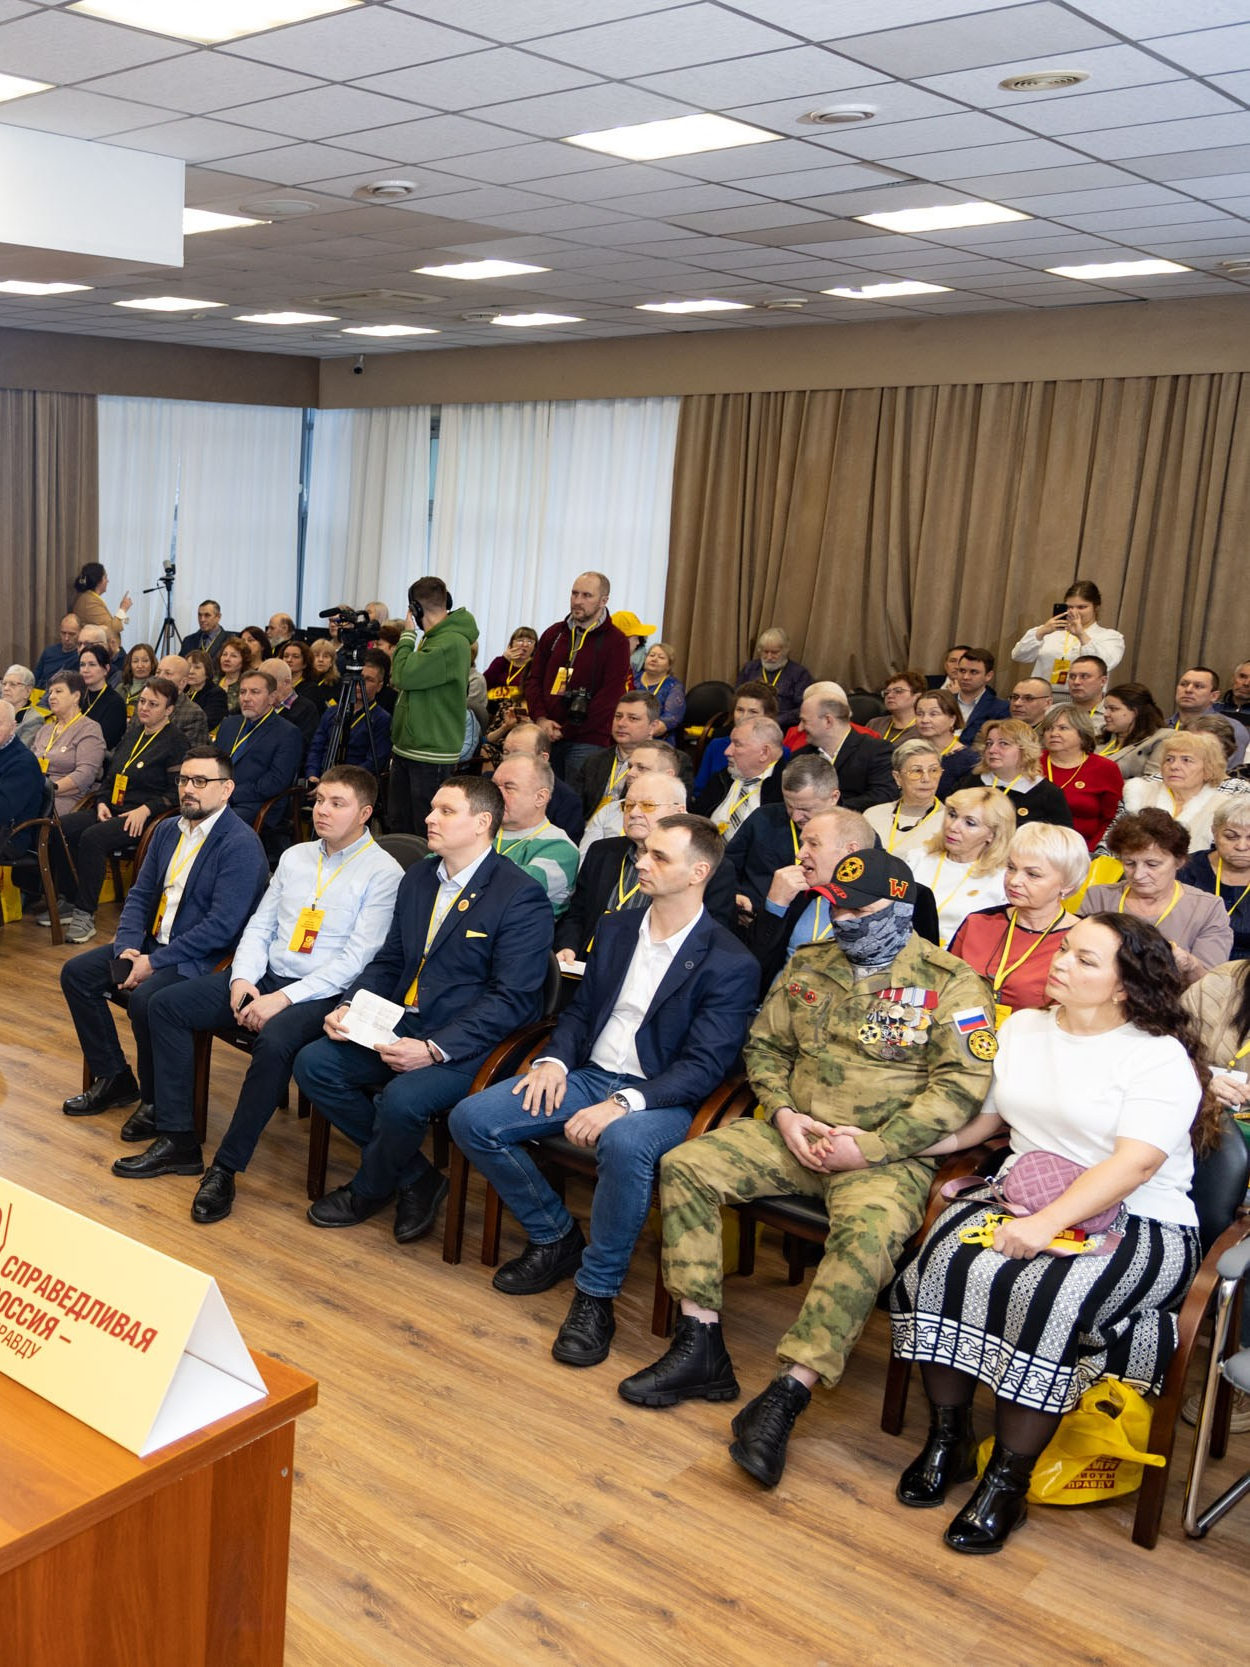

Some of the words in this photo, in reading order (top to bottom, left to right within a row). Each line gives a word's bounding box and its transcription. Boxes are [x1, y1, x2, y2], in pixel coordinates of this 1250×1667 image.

[888, 877, 909, 899] W
[0, 1255, 158, 1354] СПРАВЕДЛИВАЯ
[1067, 1480, 1113, 1489] ПРАВДУ
